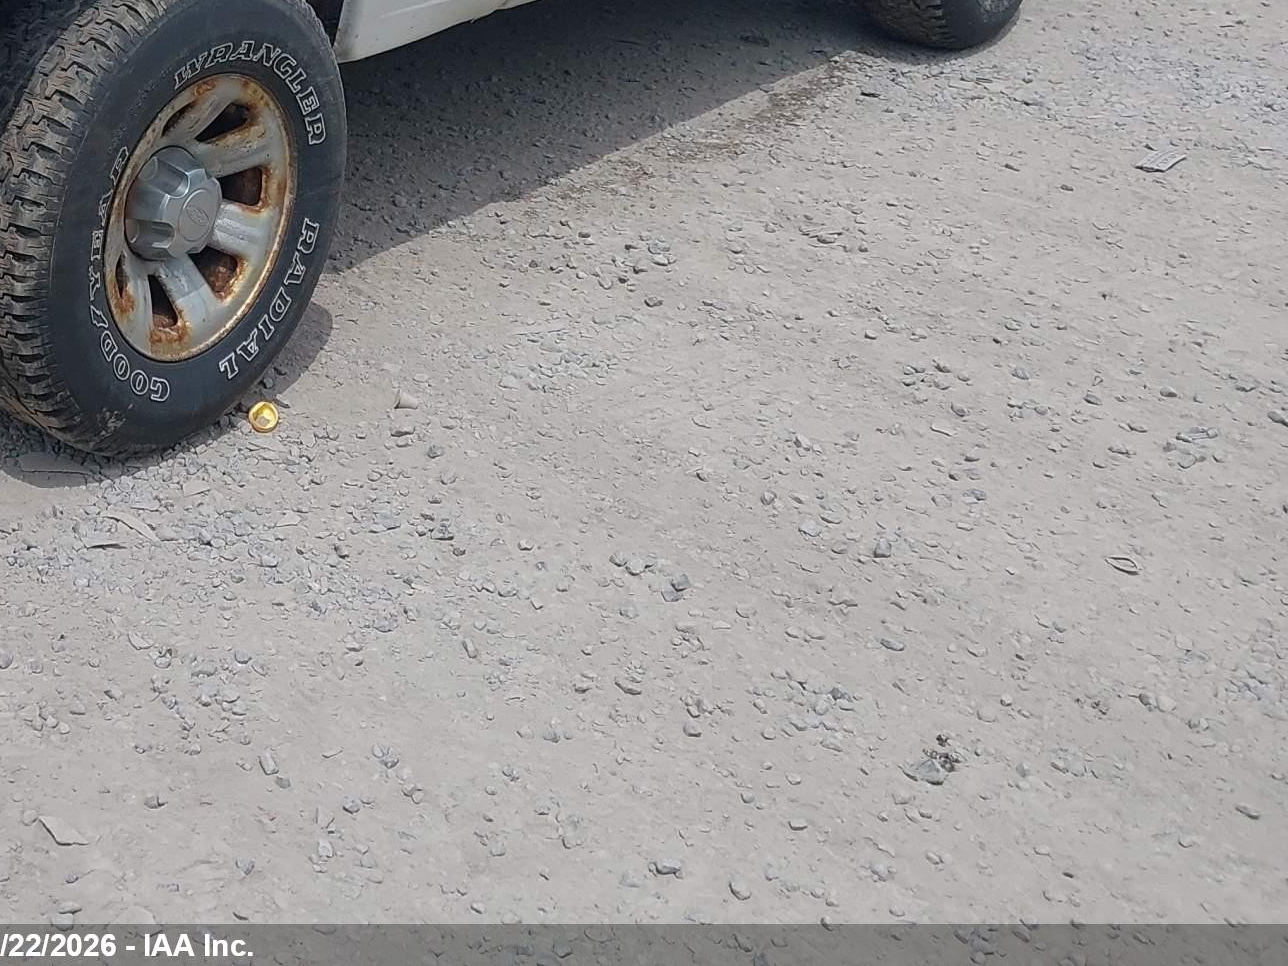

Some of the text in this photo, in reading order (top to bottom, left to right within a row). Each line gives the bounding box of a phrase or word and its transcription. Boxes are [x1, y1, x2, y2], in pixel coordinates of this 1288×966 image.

[173, 40, 326, 146] WRANGLER
[89, 145, 170, 402] GOODYEAR
[219, 217, 321, 380] RADIAL
